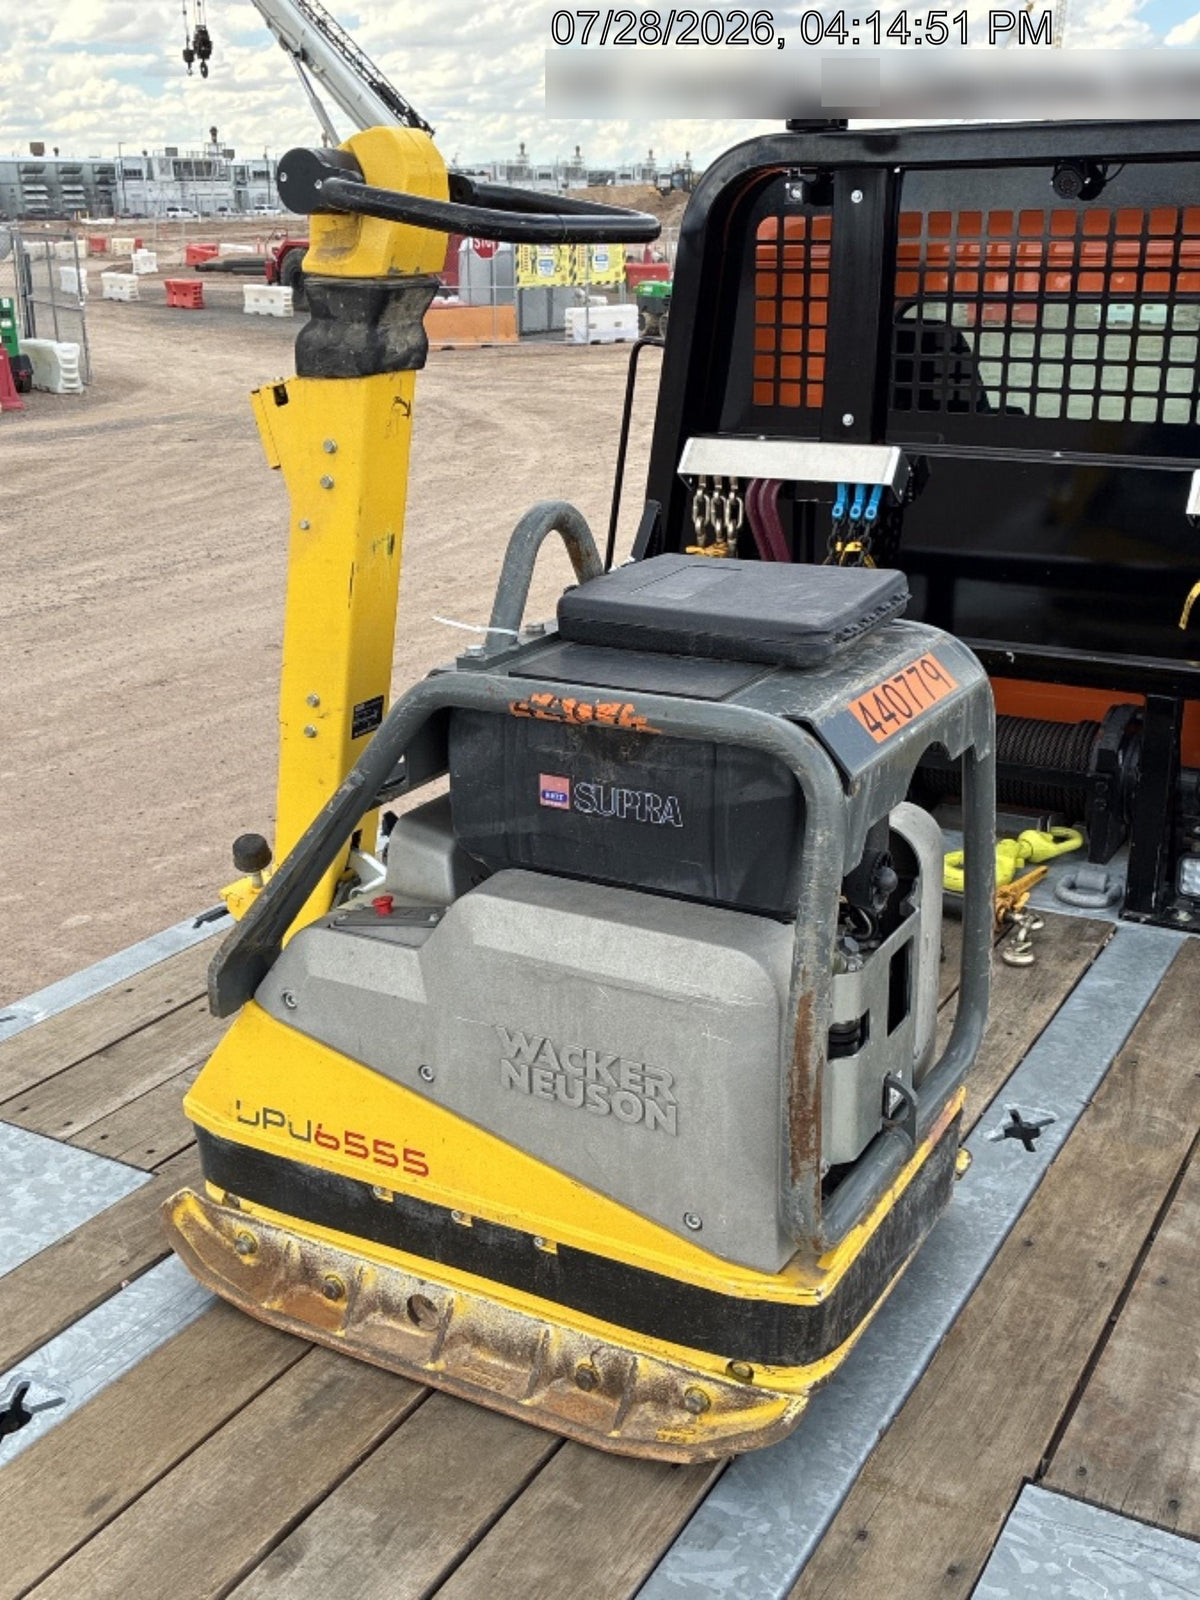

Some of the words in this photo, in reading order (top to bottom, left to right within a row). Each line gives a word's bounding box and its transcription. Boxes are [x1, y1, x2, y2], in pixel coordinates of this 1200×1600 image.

[858, 659, 952, 734] 440779
[573, 782, 683, 827] SUPRA
[496, 1025, 679, 1105] WACKER
[499, 1057, 678, 1137] NEUSON
